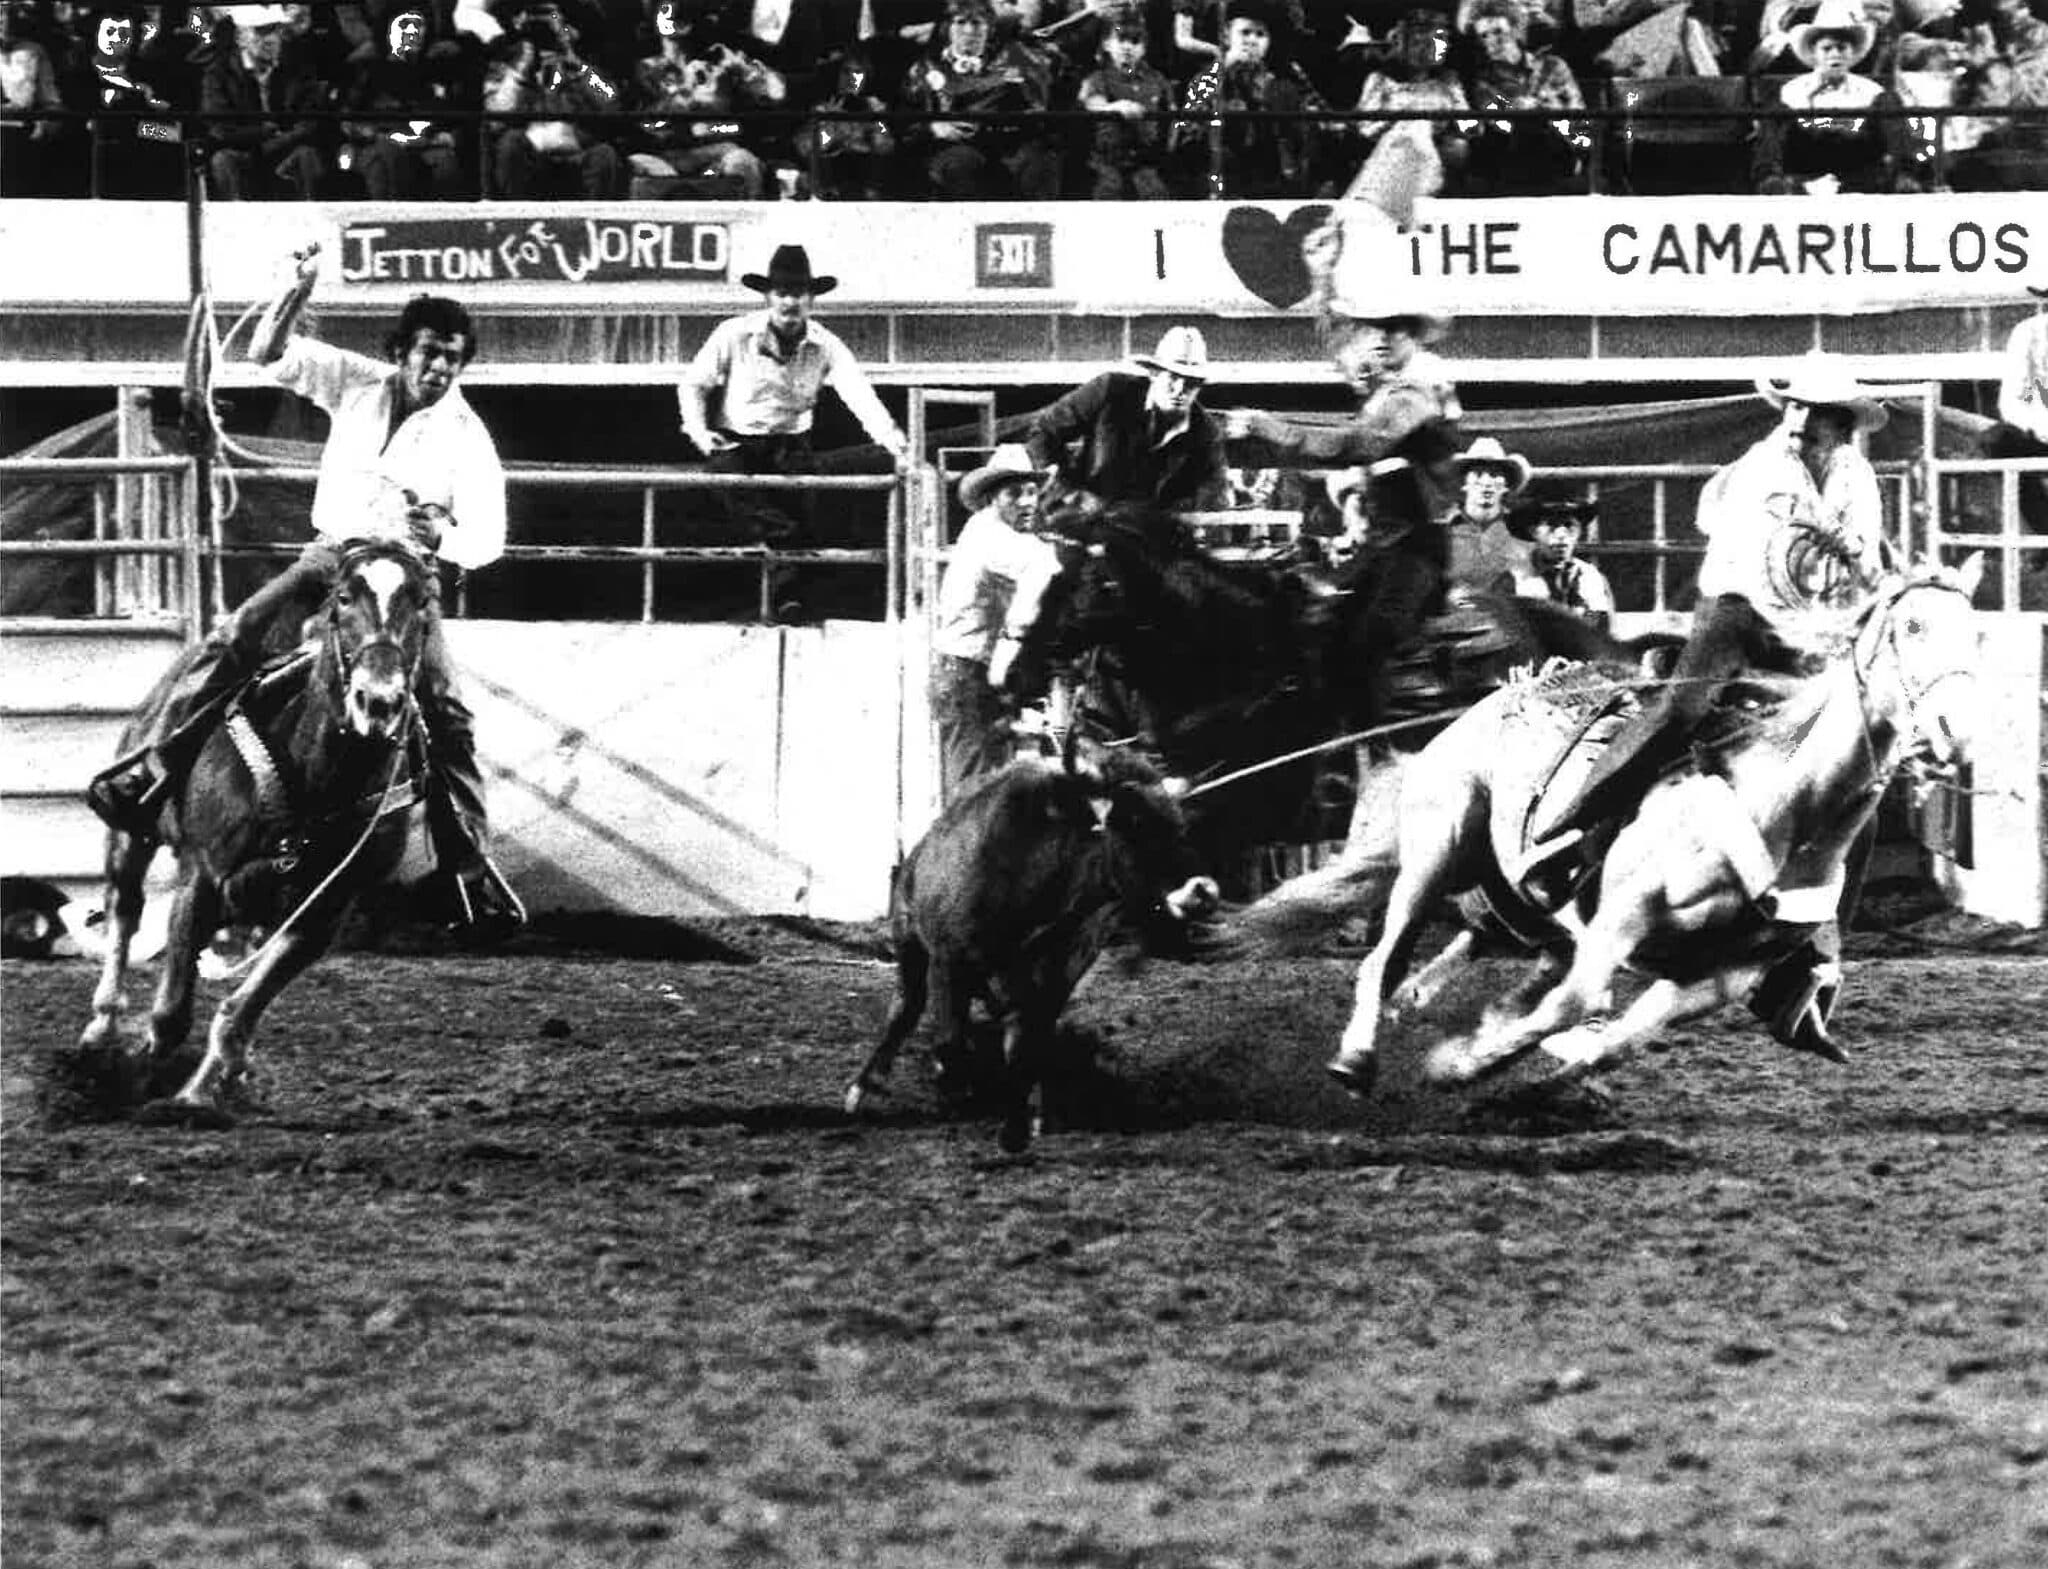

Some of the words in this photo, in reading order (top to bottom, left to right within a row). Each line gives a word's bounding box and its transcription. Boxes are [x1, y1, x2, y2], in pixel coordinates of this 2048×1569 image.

[552, 219, 728, 282] WORLD
[1155, 228, 1166, 279] I
[1397, 222, 1521, 275] THE
[1602, 220, 2030, 275] CAMARILLOS
